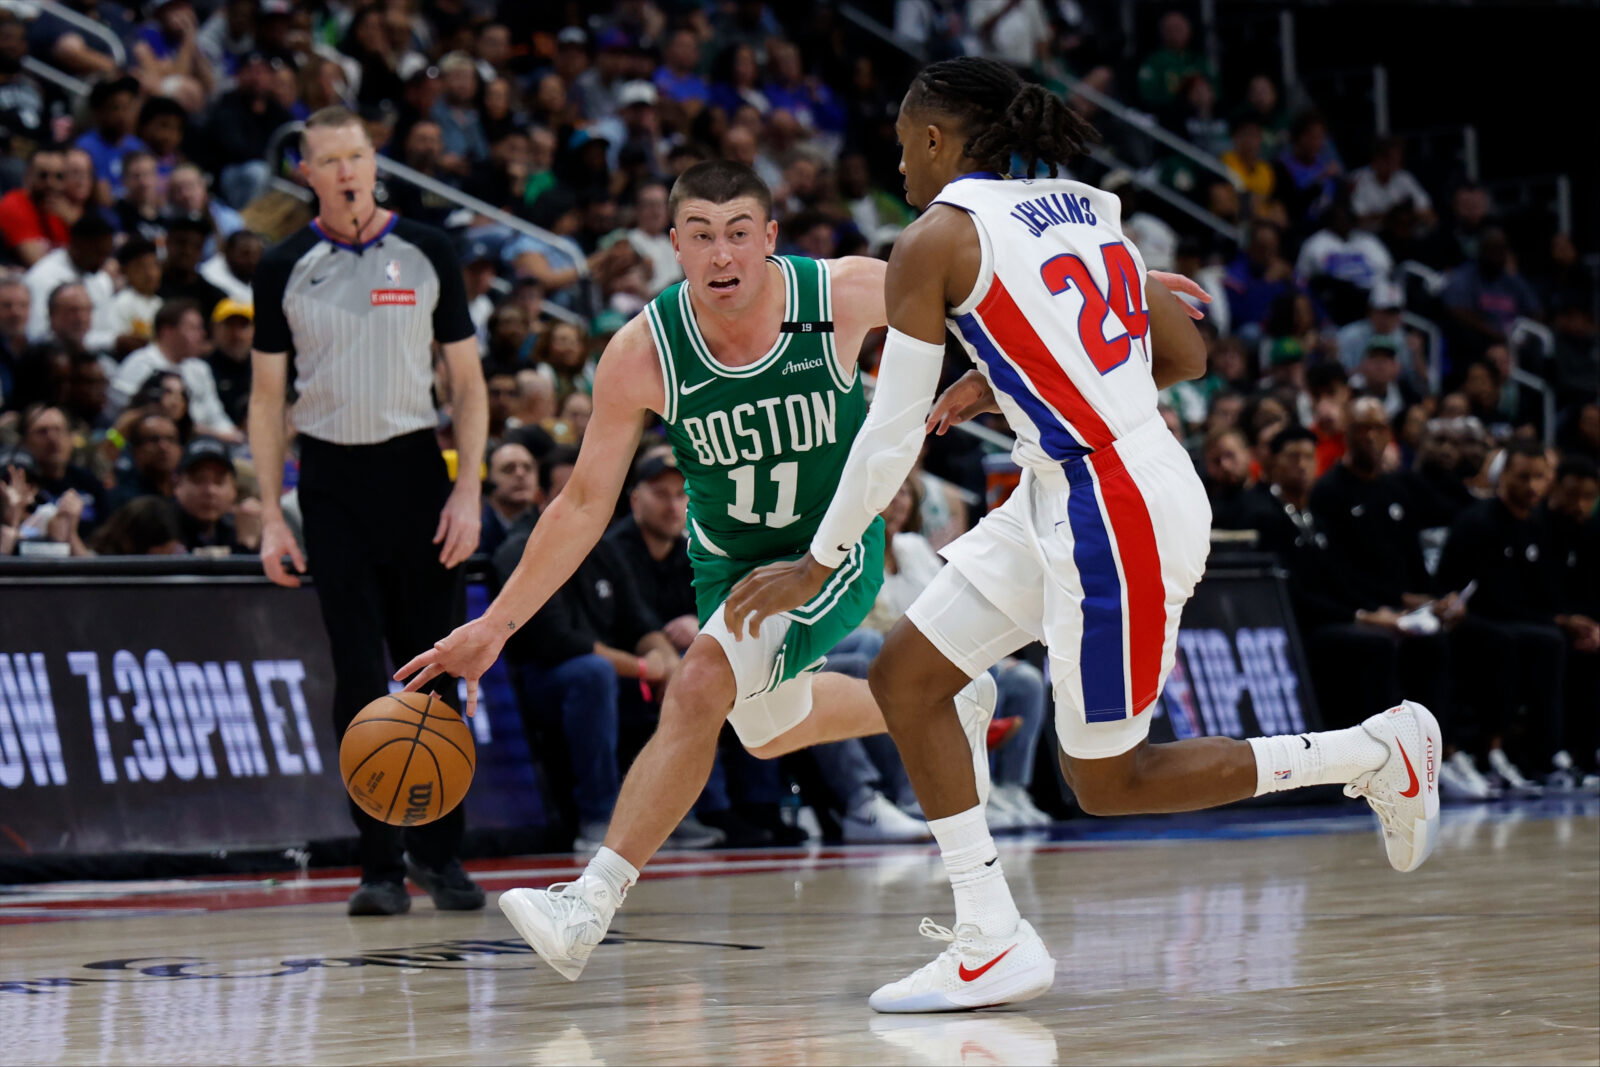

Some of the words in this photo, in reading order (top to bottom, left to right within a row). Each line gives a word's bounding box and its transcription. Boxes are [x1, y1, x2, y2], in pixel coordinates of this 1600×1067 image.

[801, 322, 812, 332] 19
[1040, 241, 1150, 376] 24
[782, 358, 824, 375] Amica
[682, 390, 837, 466] BOSTON
[727, 461, 801, 529] 11
[66, 648, 269, 784] 7:30PM
[252, 660, 323, 776] ET
